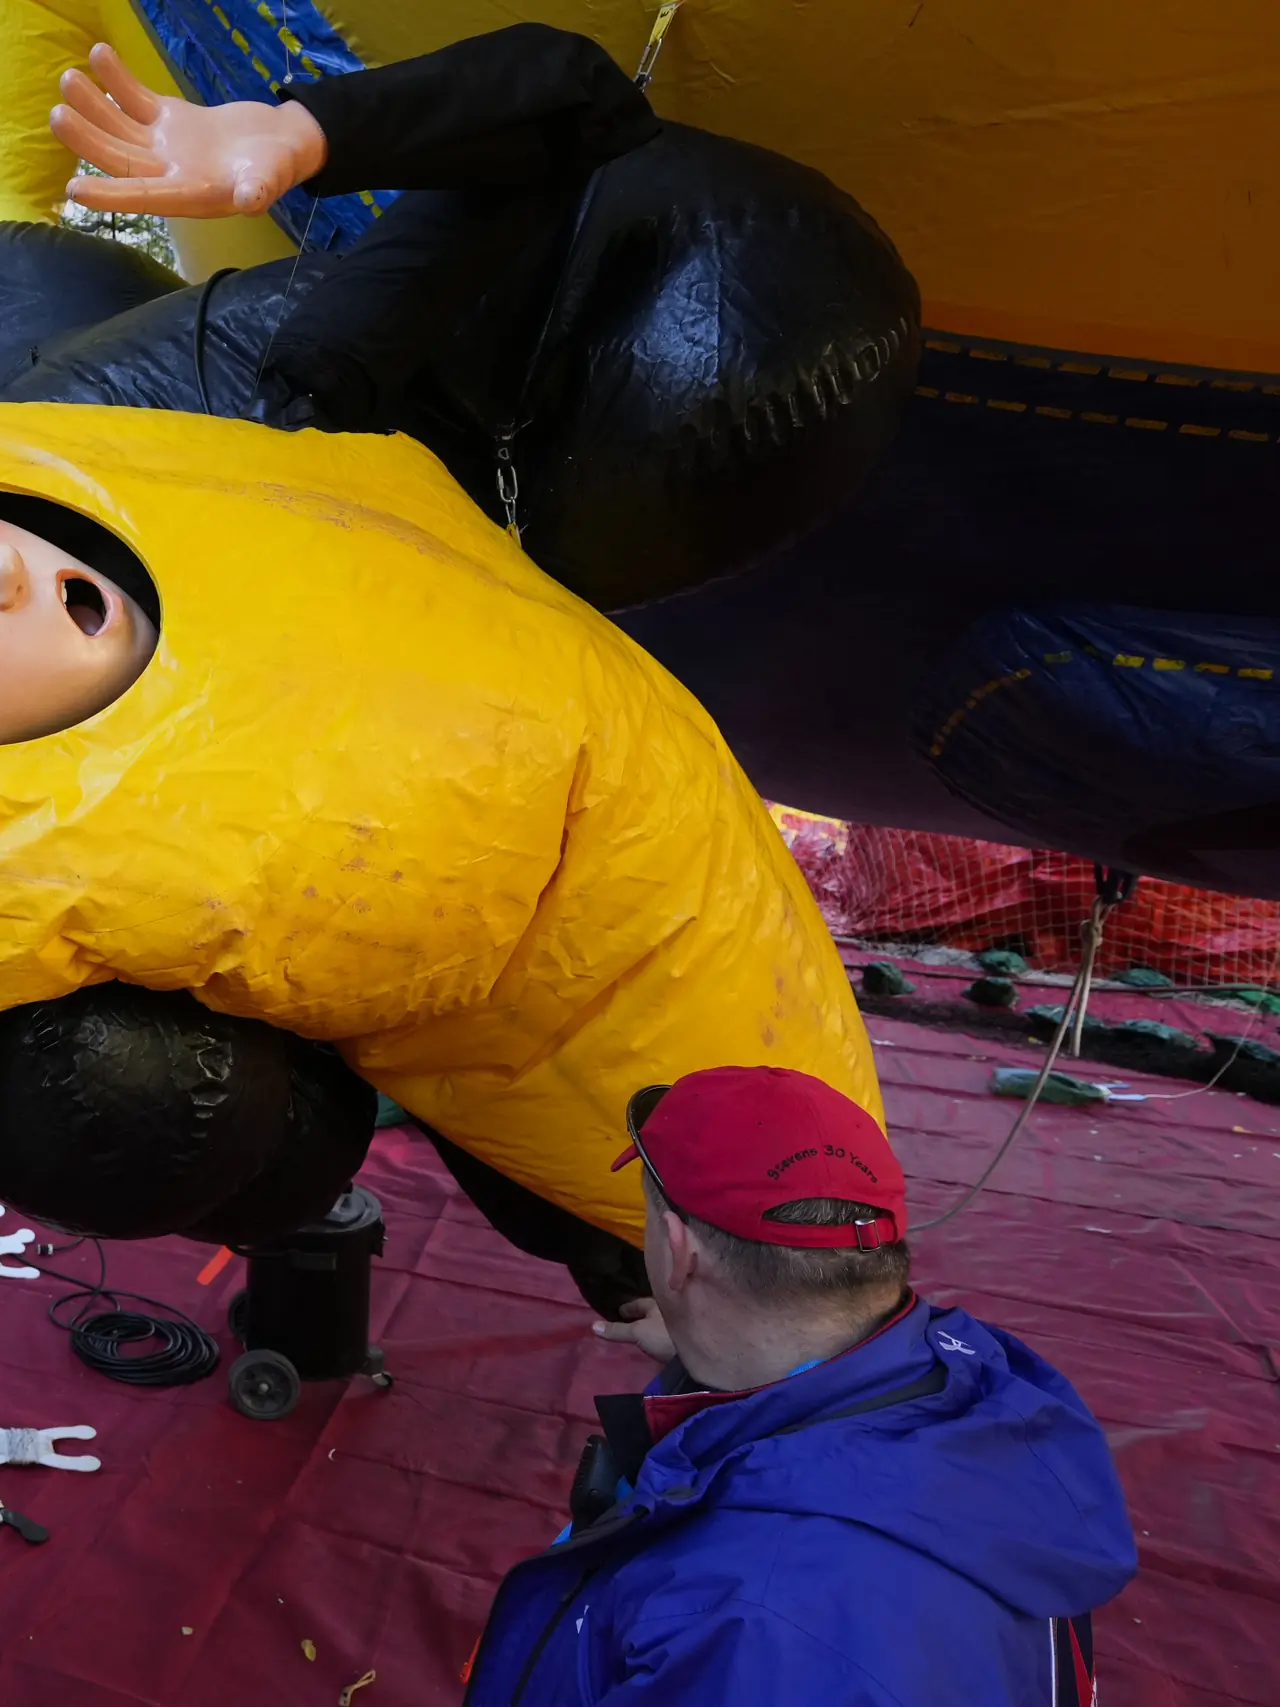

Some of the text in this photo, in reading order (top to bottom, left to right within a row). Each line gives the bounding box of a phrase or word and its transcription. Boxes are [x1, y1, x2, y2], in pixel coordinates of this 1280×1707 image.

[767, 1145, 878, 1184] Stevens 30 Years
